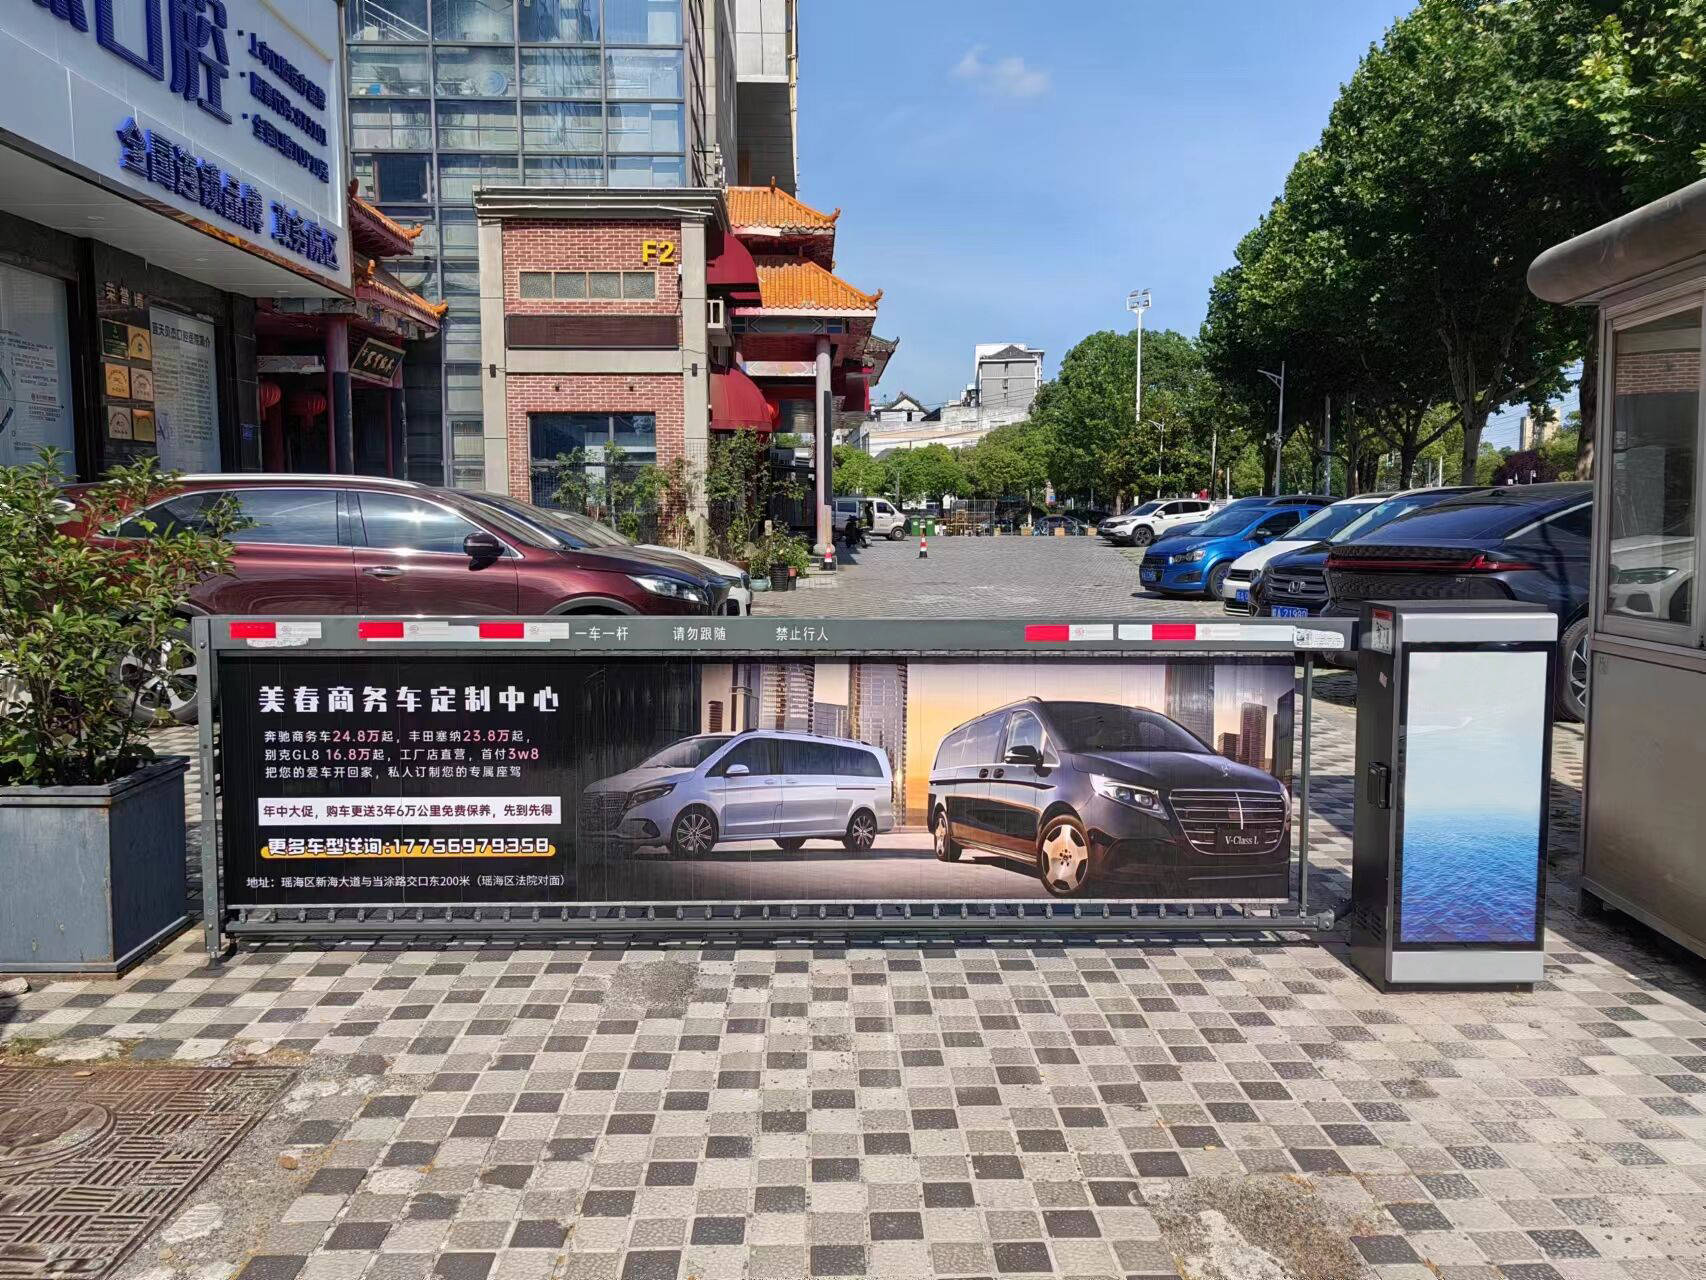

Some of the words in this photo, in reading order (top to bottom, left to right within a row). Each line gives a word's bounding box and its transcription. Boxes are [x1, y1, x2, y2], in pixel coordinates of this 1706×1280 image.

[642, 240, 675, 264] F2
[575, 626, 629, 642] 一车一杆
[673, 626, 727, 642] 请勿跟随
[775, 626, 829, 642] 禁止行人
[258, 685, 560, 714] 美春商务车定制中心
[264, 749, 319, 761] 别克GL8
[1225, 835, 1252, 845] V-Class
